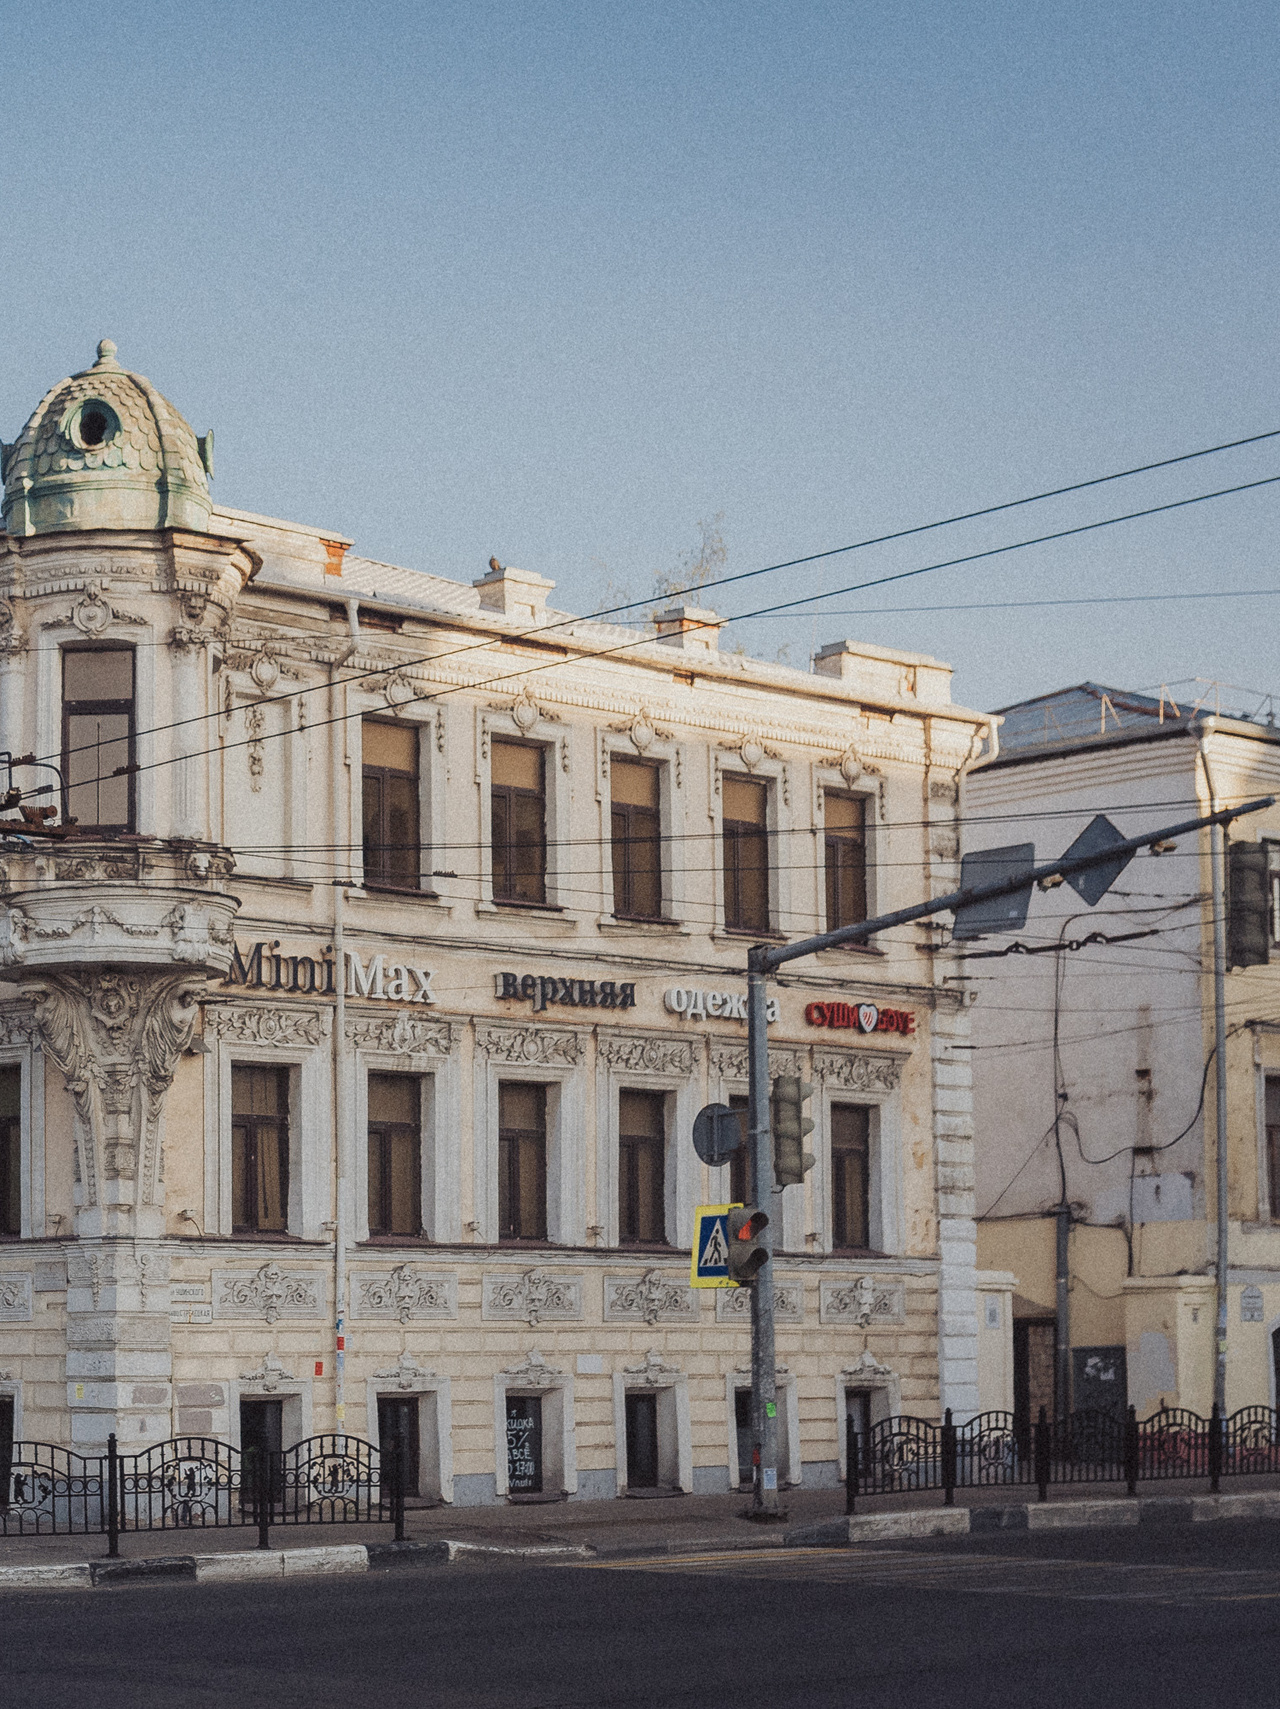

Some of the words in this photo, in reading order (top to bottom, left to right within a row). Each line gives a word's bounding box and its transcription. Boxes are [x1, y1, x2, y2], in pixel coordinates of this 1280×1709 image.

[493, 972, 637, 1011] верхняя
[664, 986, 782, 1023] одежа
[506, 1417, 535, 1430] КИДКА
